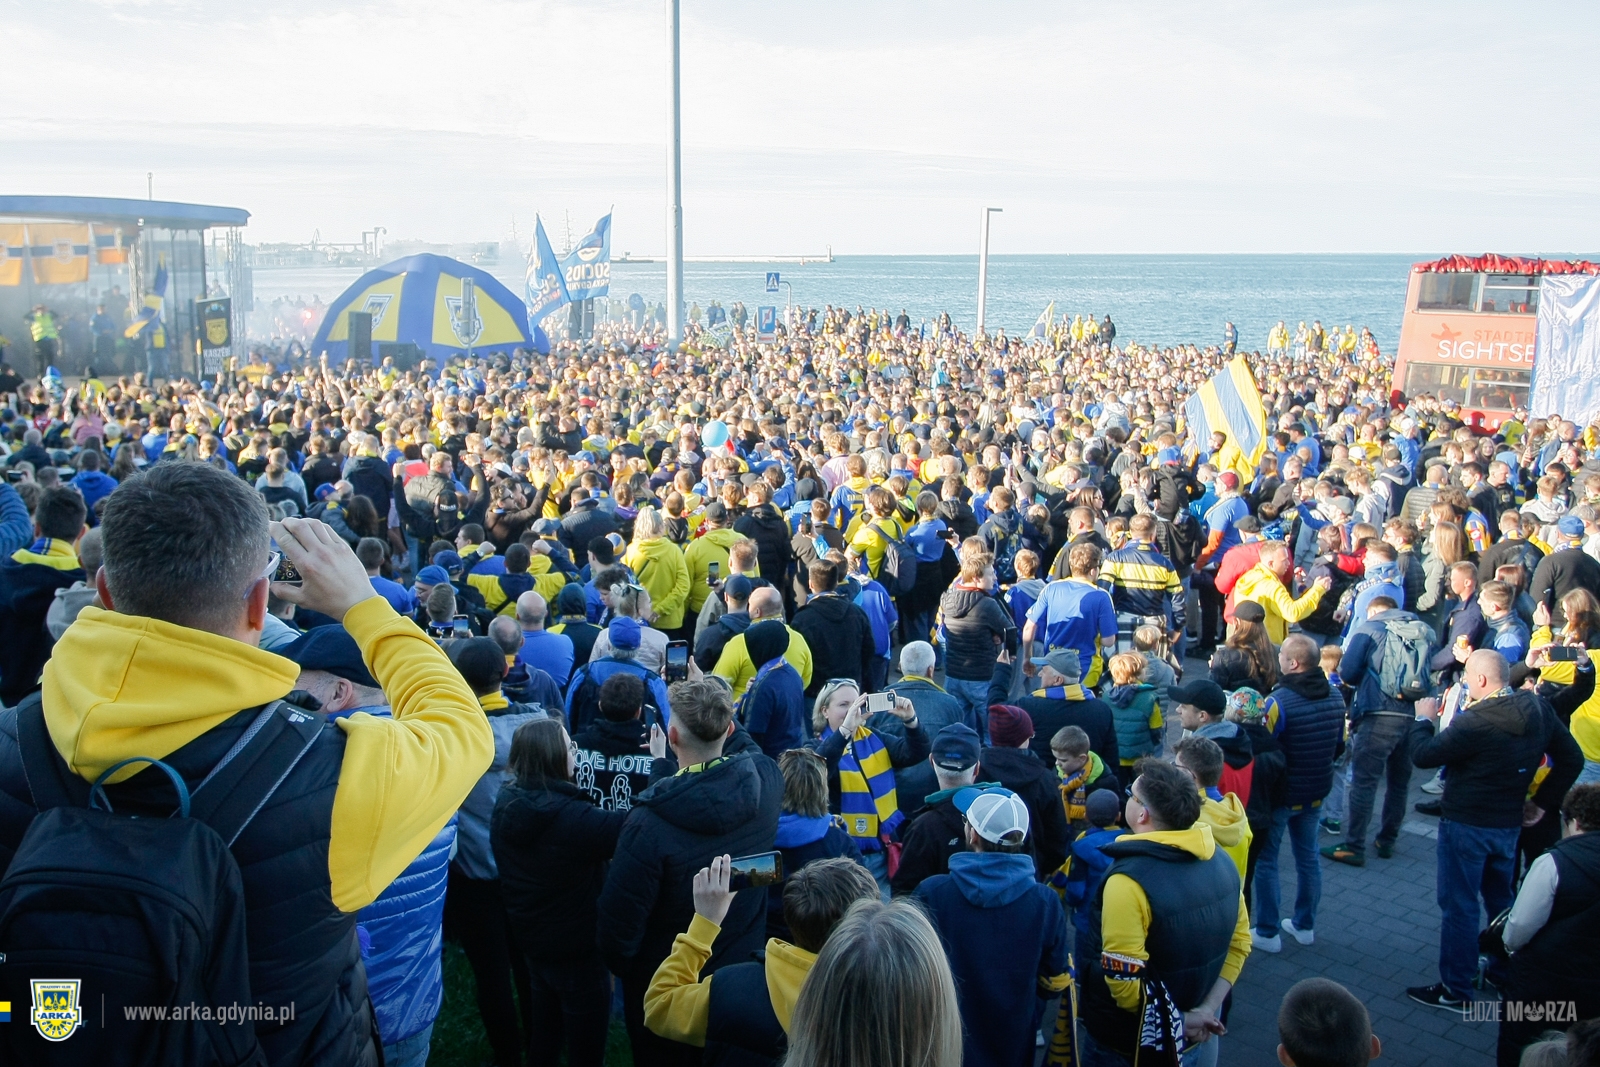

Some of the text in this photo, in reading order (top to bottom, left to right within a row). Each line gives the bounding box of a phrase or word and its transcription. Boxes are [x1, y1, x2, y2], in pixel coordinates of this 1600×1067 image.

[1473, 329, 1534, 343] STADTR
[1437, 339, 1535, 363] SIGHTSE
[574, 748, 655, 775] OVE HOTE
